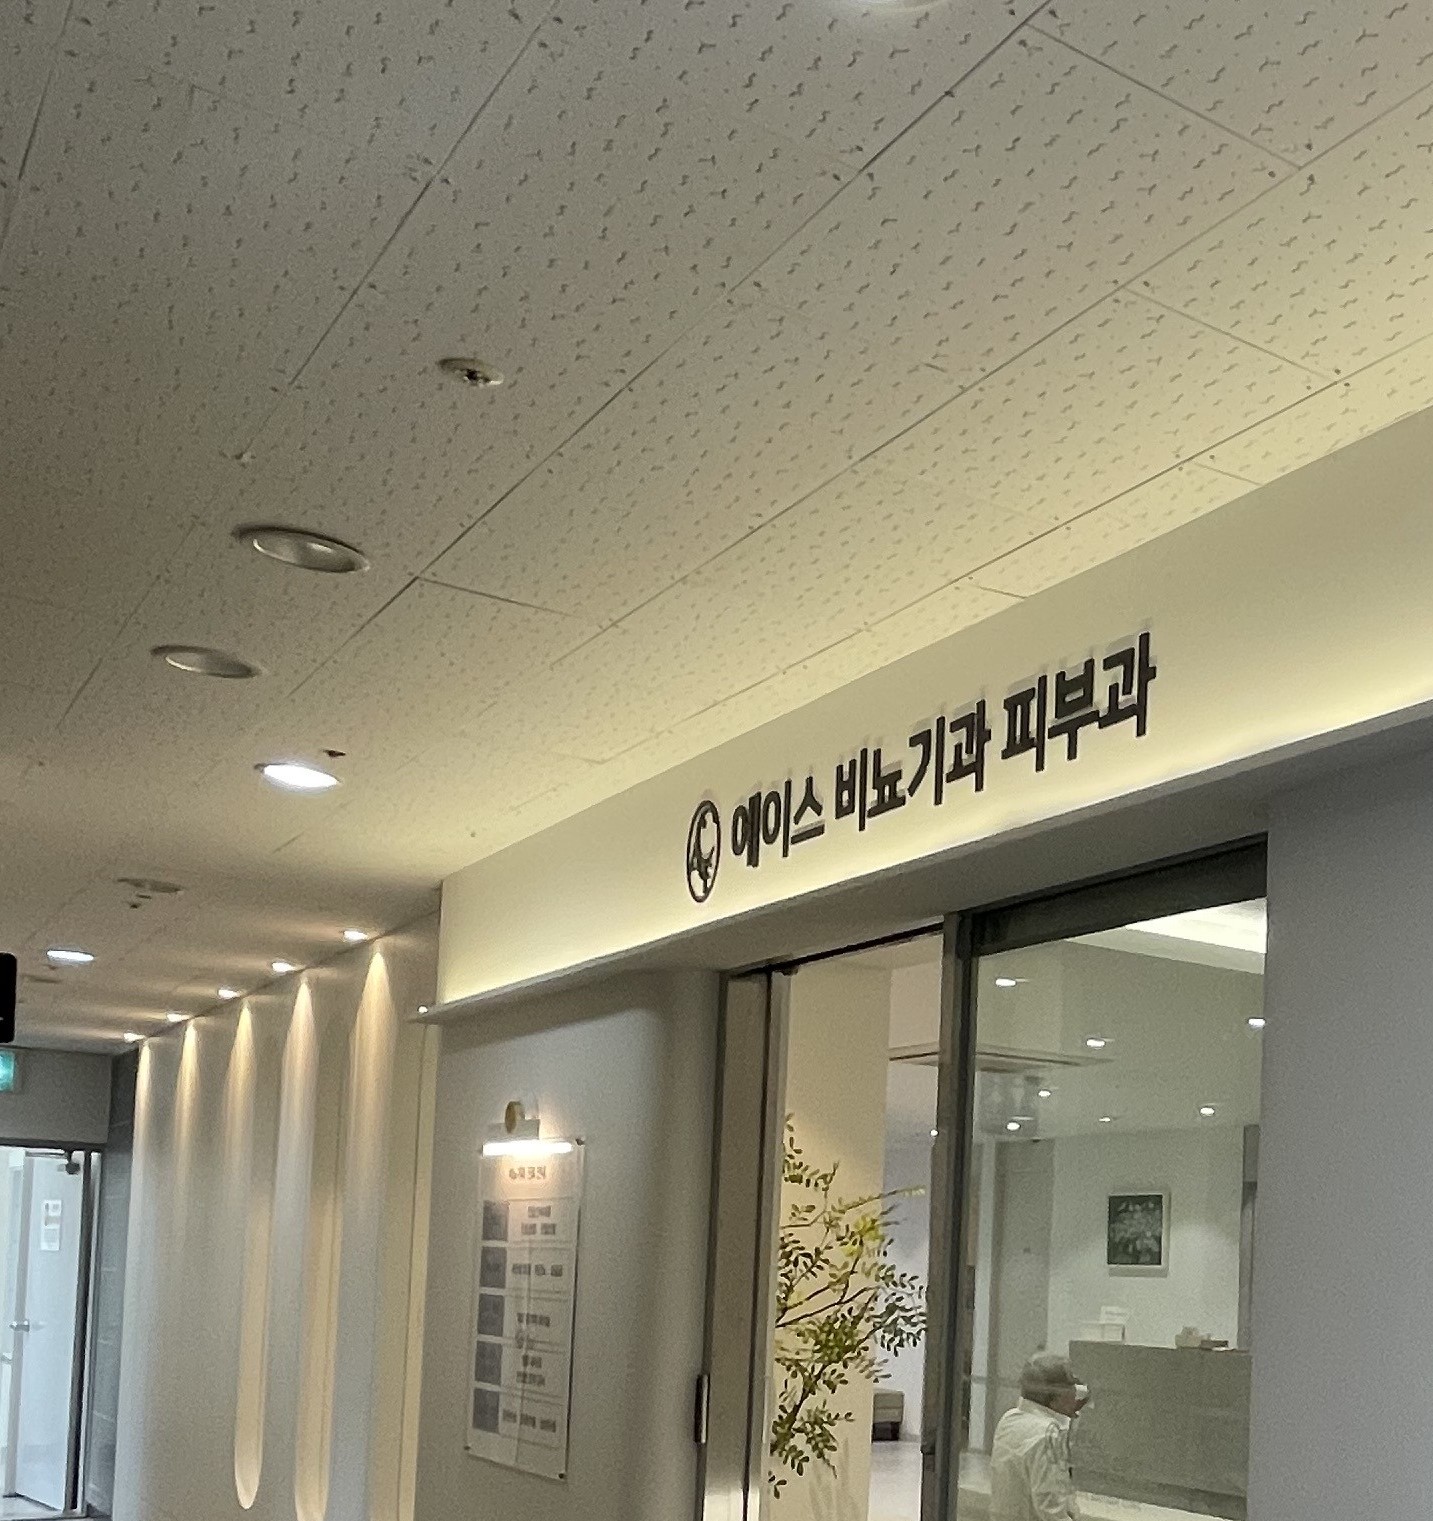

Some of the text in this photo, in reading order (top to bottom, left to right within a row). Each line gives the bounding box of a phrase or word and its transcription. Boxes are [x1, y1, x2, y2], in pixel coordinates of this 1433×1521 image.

[732, 632, 1157, 868] 에이스 비뇨기과 피부과
